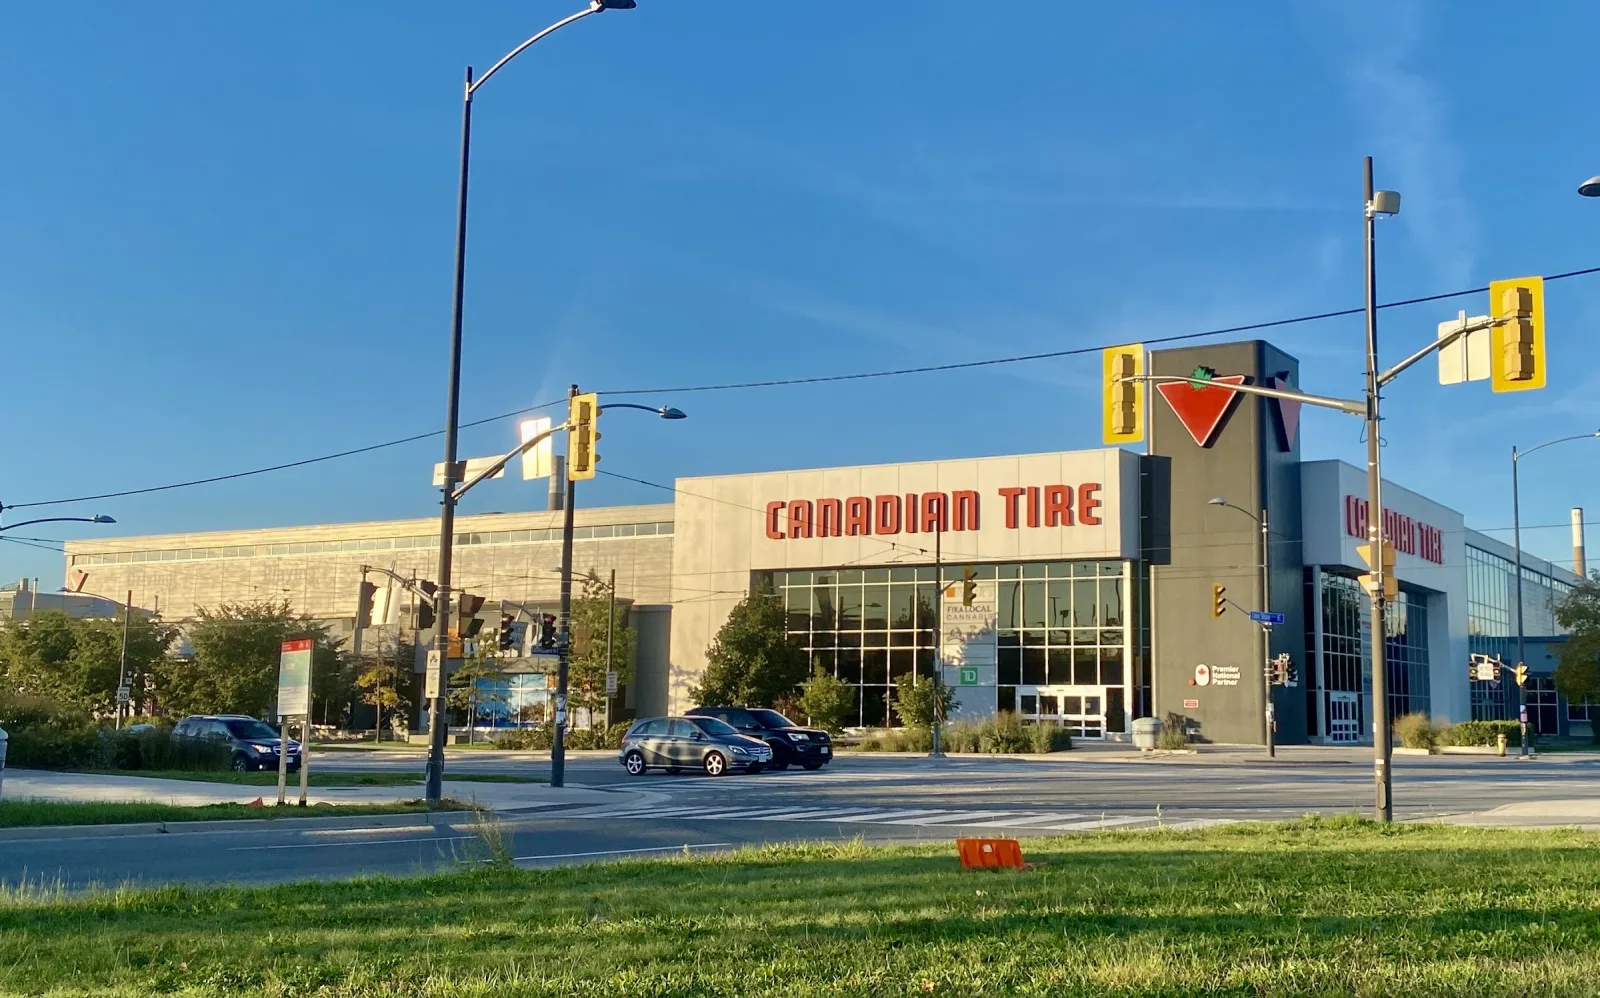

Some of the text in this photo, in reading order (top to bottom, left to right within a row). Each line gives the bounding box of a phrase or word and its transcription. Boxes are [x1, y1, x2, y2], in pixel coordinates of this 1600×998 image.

[766, 483, 1102, 539] CANADIAN TIRE
[1345, 494, 1416, 556] CADIAN
[946, 613, 993, 621] CANNABIS
[1212, 665, 1240, 673] Premier
[961, 669, 977, 682] TD
[119, 692, 128, 700] 50
